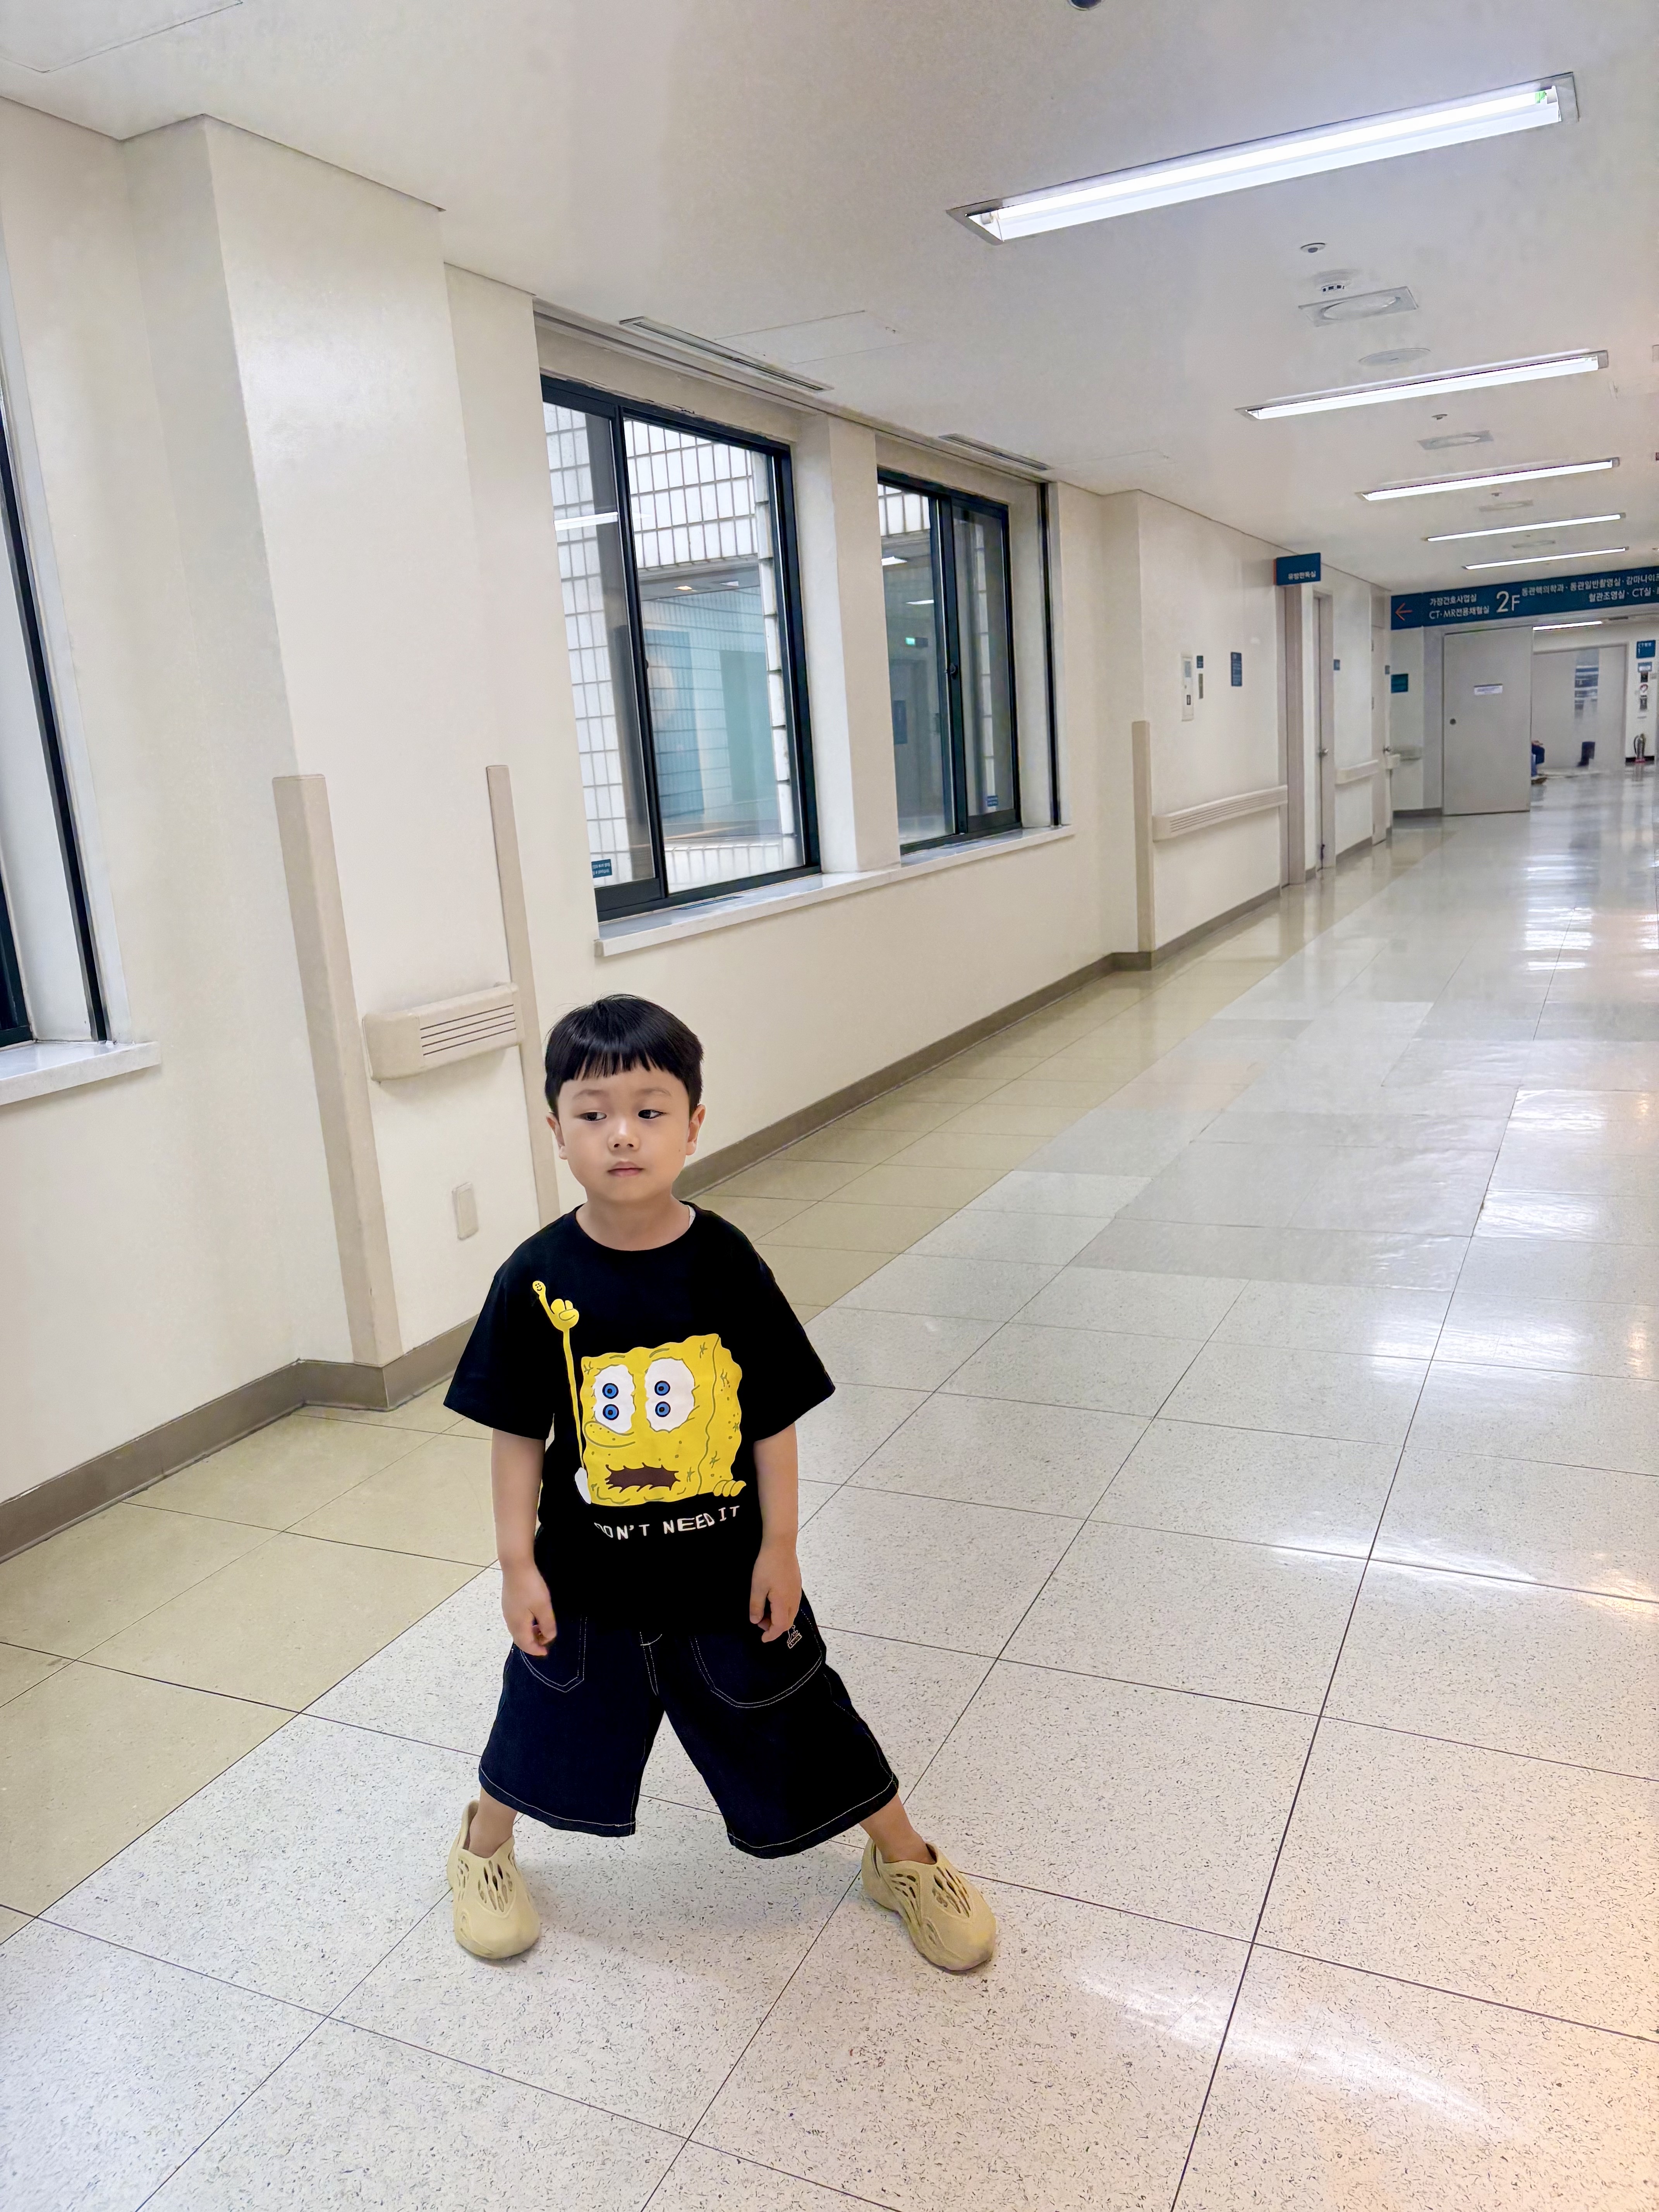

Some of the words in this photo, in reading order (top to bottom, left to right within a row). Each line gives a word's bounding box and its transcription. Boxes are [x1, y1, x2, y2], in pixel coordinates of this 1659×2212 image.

[1496, 591, 1520, 613] 2F
[663, 1513, 715, 1534] NEED
[718, 1506, 740, 1522] IT
